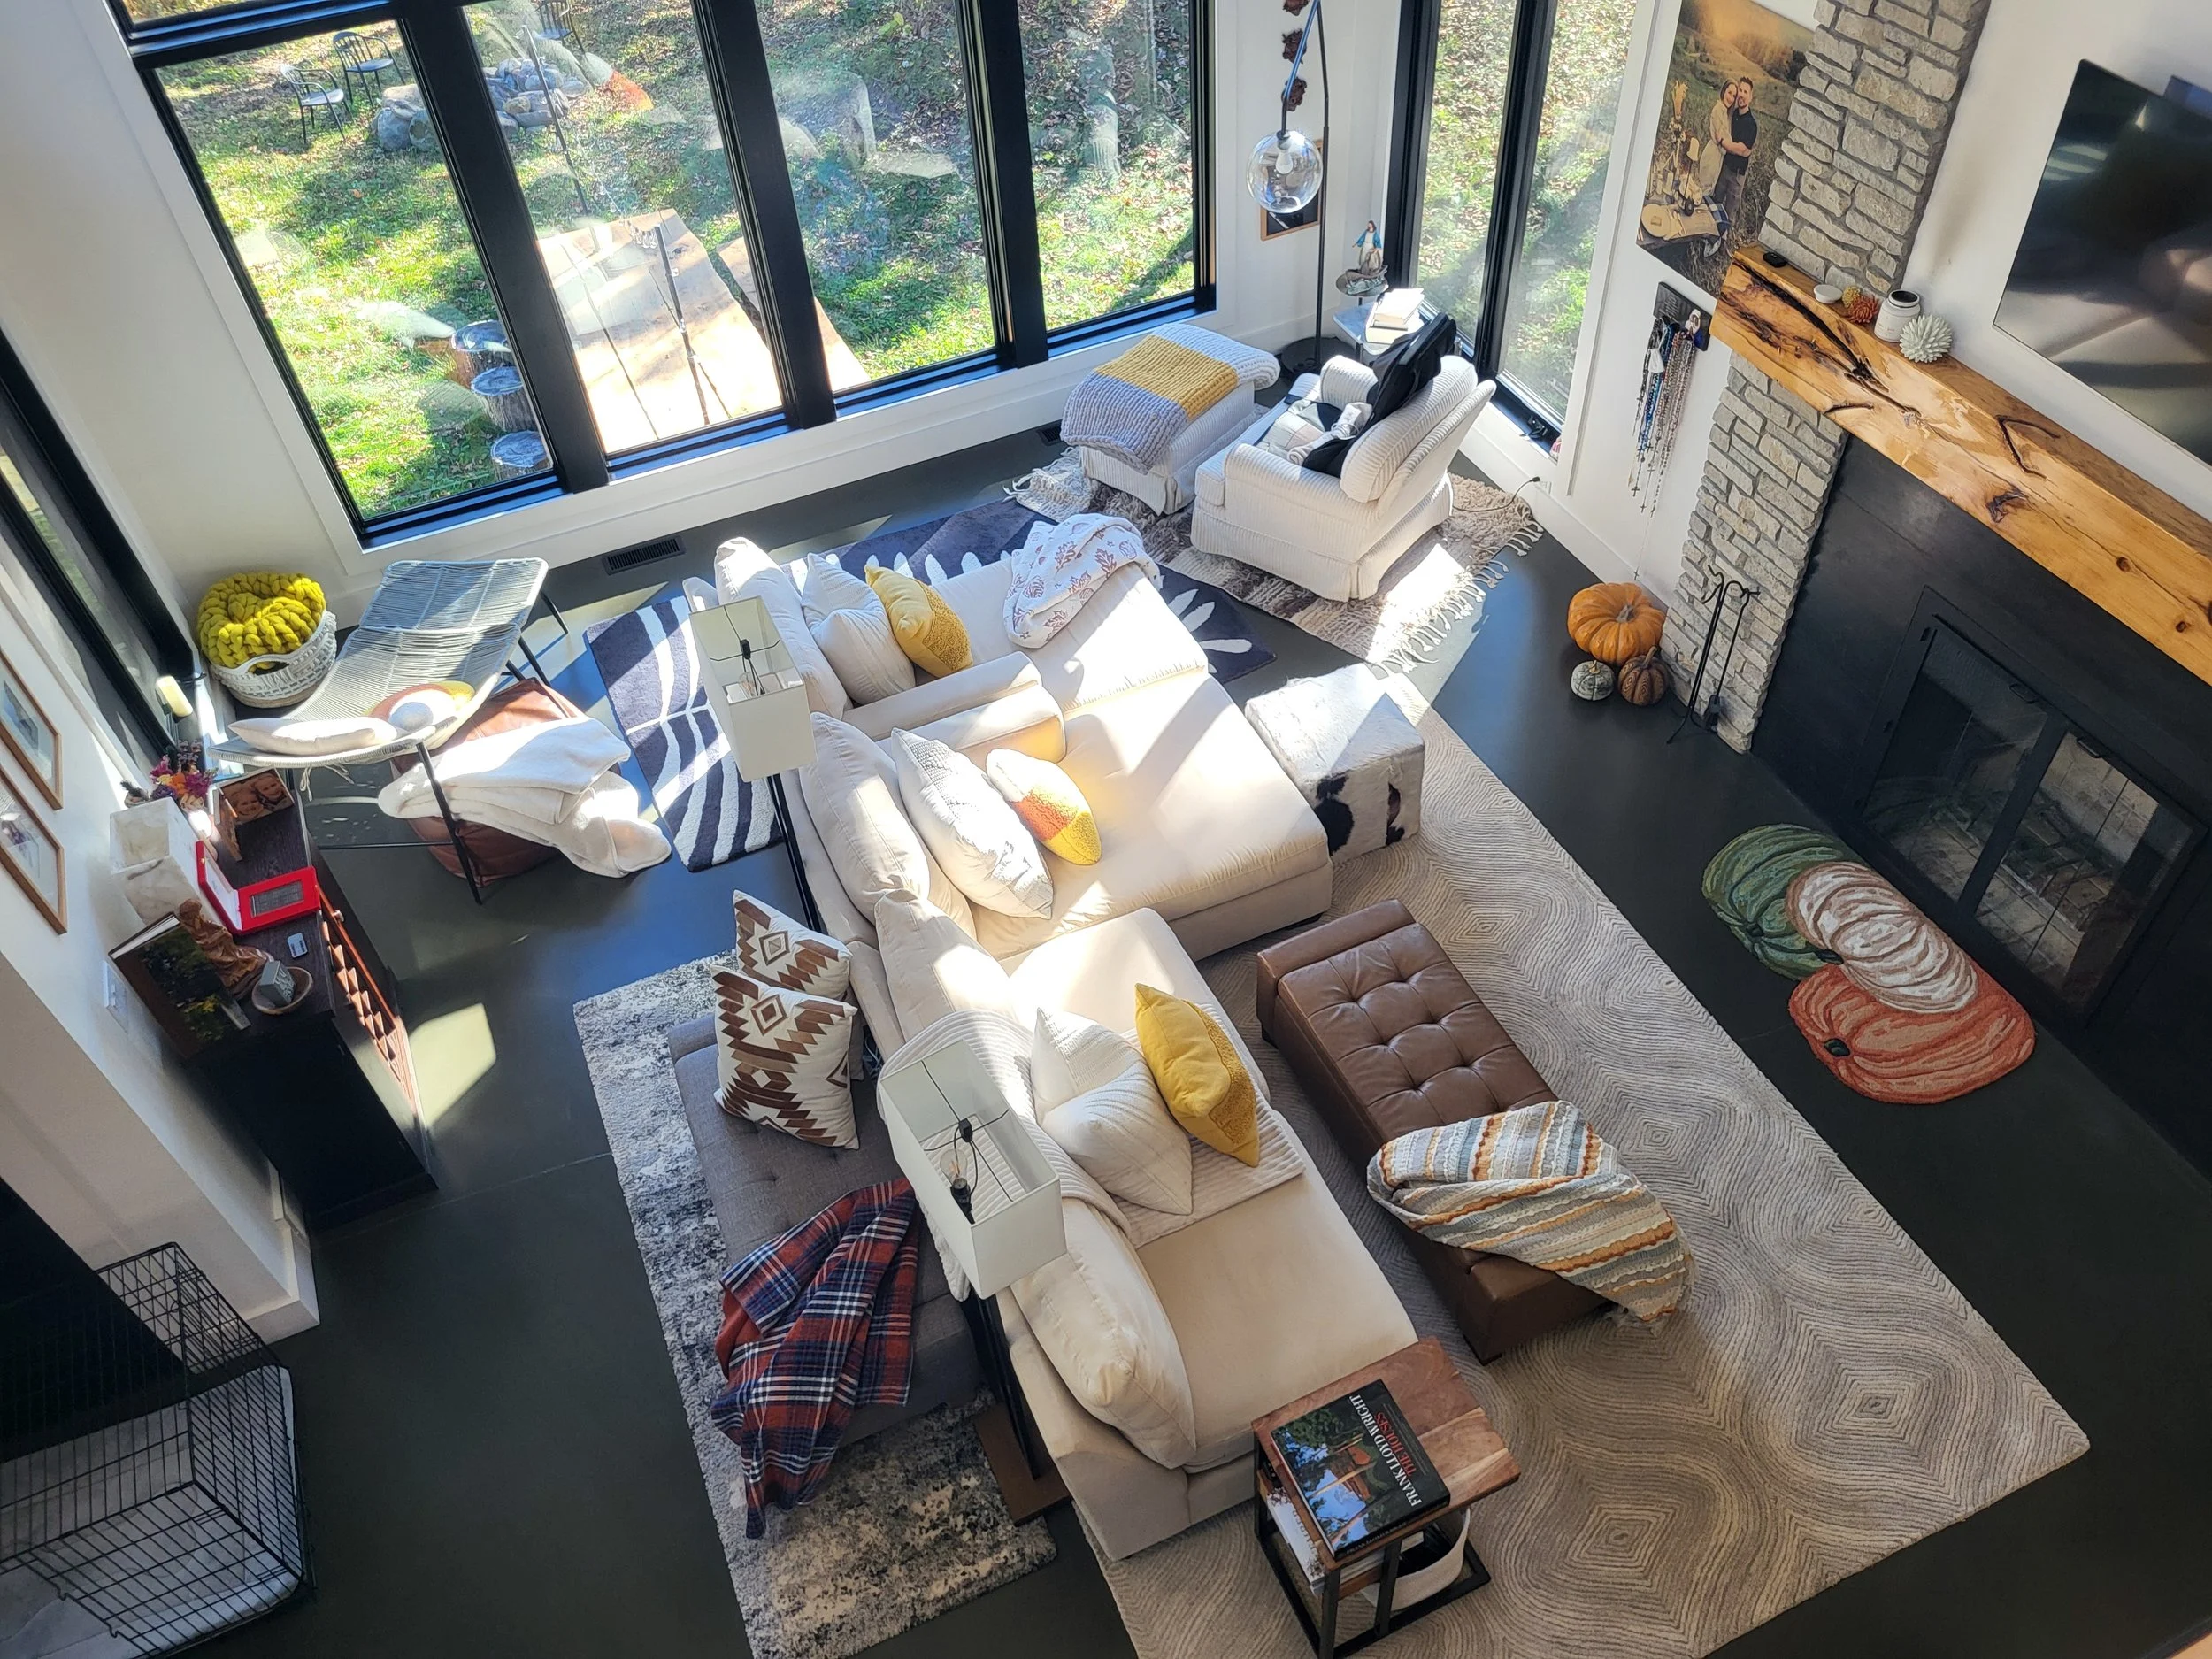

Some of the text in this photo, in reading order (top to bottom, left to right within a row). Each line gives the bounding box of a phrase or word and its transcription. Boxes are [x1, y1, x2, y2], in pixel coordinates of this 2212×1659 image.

[1349, 1394, 1379, 1436] WRIGHT
[1375, 1412, 1404, 1454] HOUSES
[1373, 1434, 1401, 1470] LLOYD
[1398, 1452, 1417, 1476] THE
[1393, 1467, 1422, 1507] FRANK
